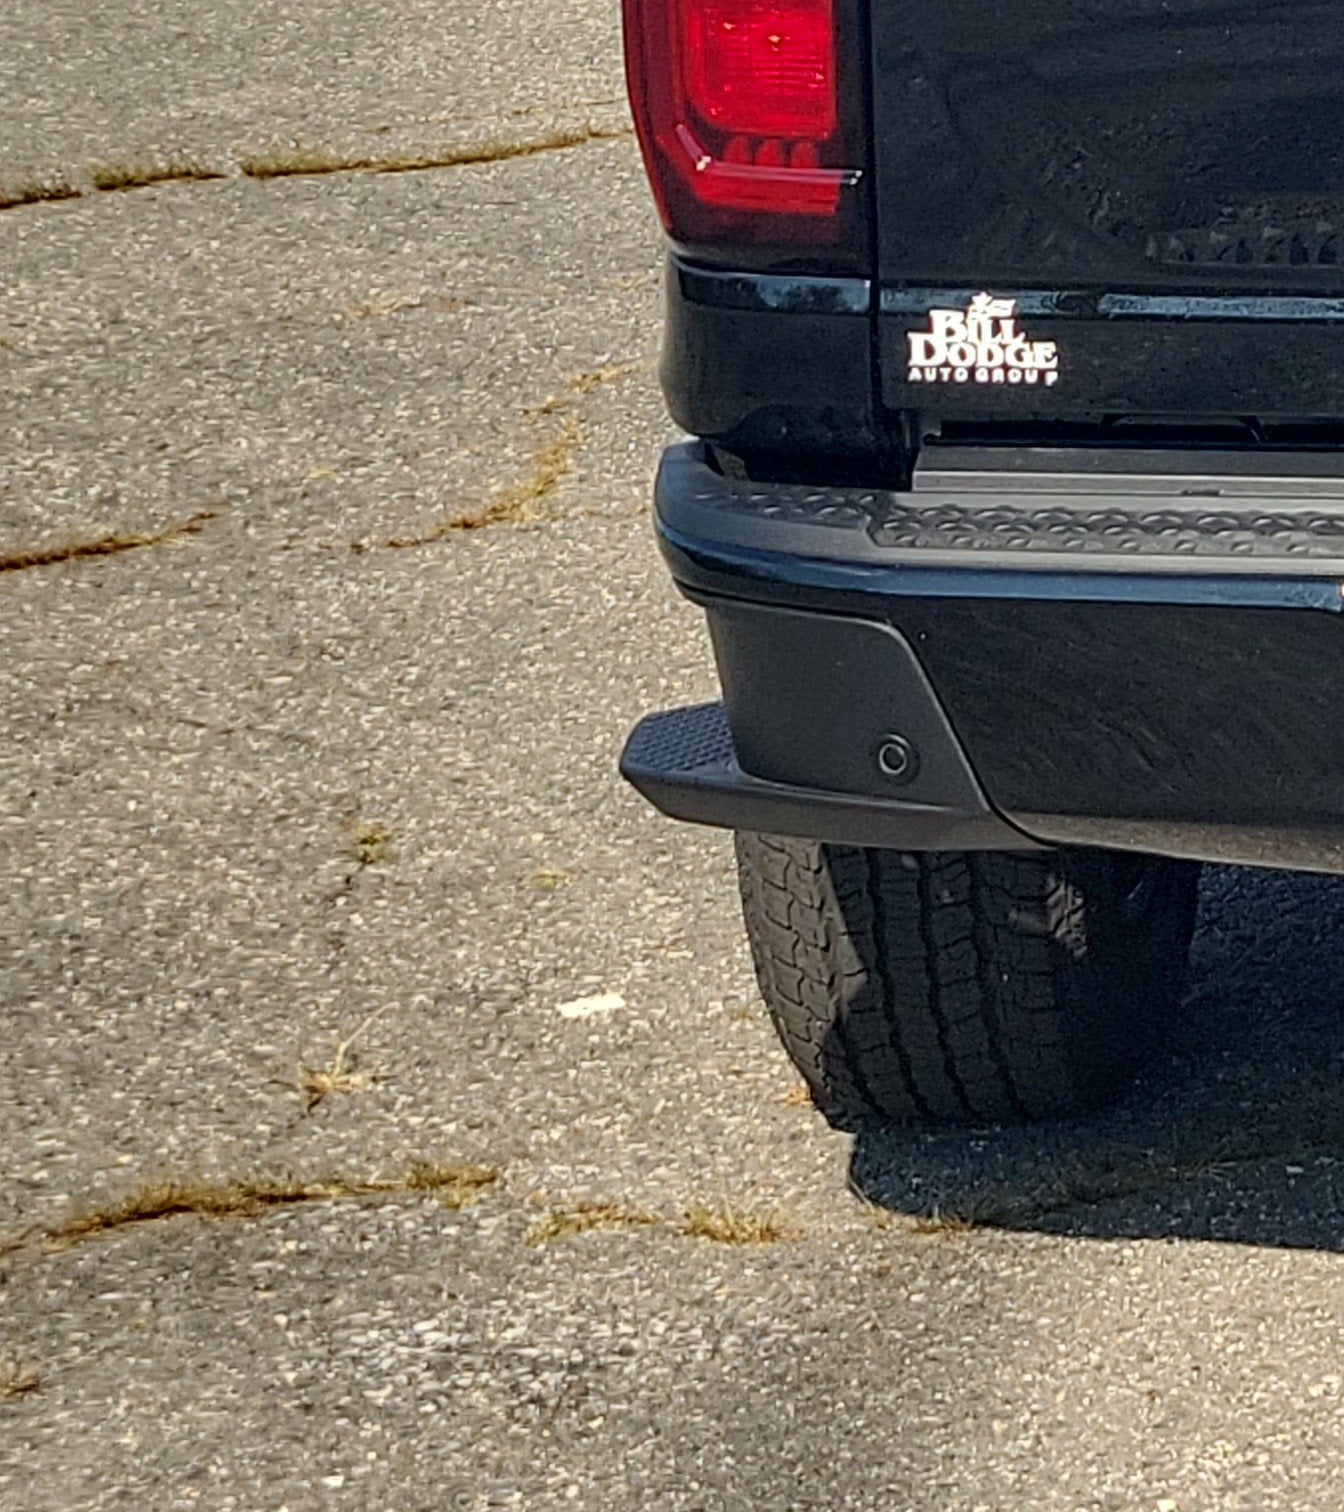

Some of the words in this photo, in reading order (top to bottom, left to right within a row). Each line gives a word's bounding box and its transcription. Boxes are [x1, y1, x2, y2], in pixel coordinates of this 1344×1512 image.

[907, 332, 1058, 369] DODGE
[908, 367, 969, 383] AUTO
[974, 367, 1059, 386] GROUP
